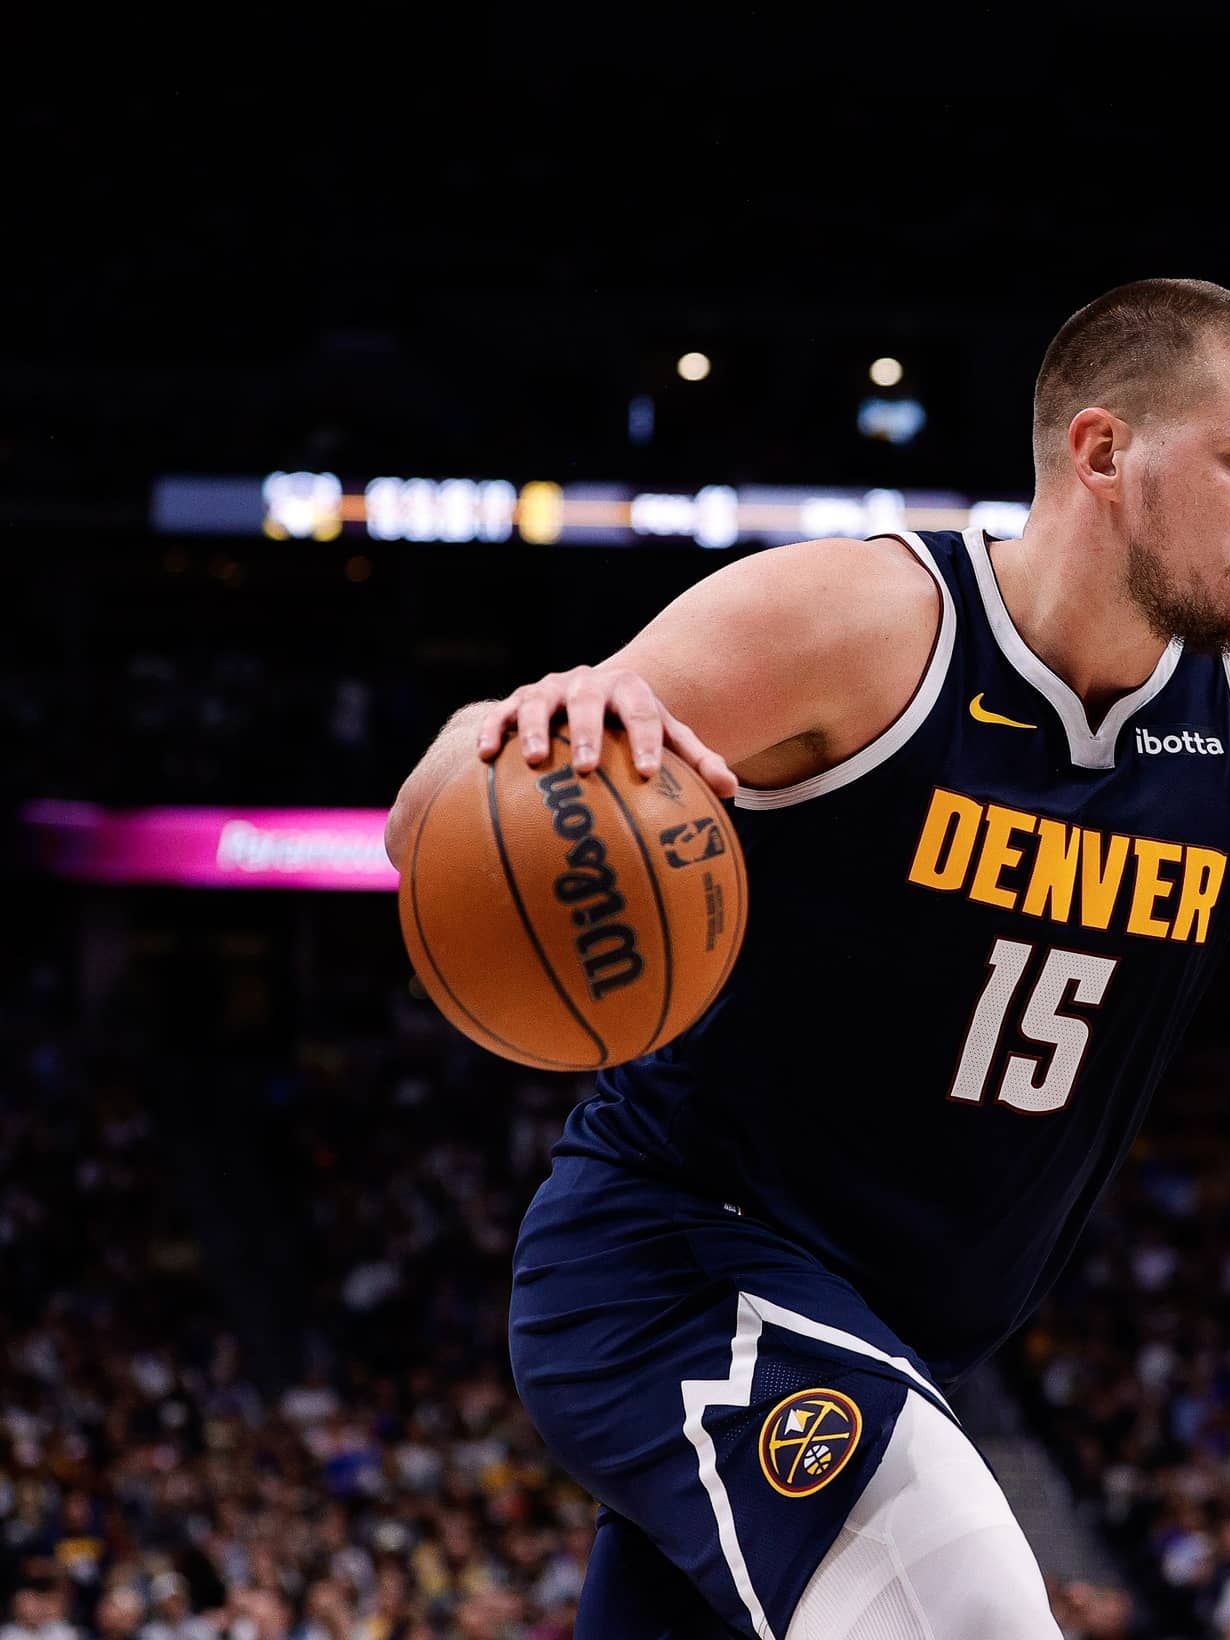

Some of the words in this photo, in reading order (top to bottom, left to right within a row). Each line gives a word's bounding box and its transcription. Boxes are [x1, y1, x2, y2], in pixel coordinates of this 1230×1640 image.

[1135, 727, 1225, 756] ibotta
[535, 762, 646, 1002] Wilson
[906, 785, 1229, 944] DENVER
[948, 937, 1120, 1115] 15
